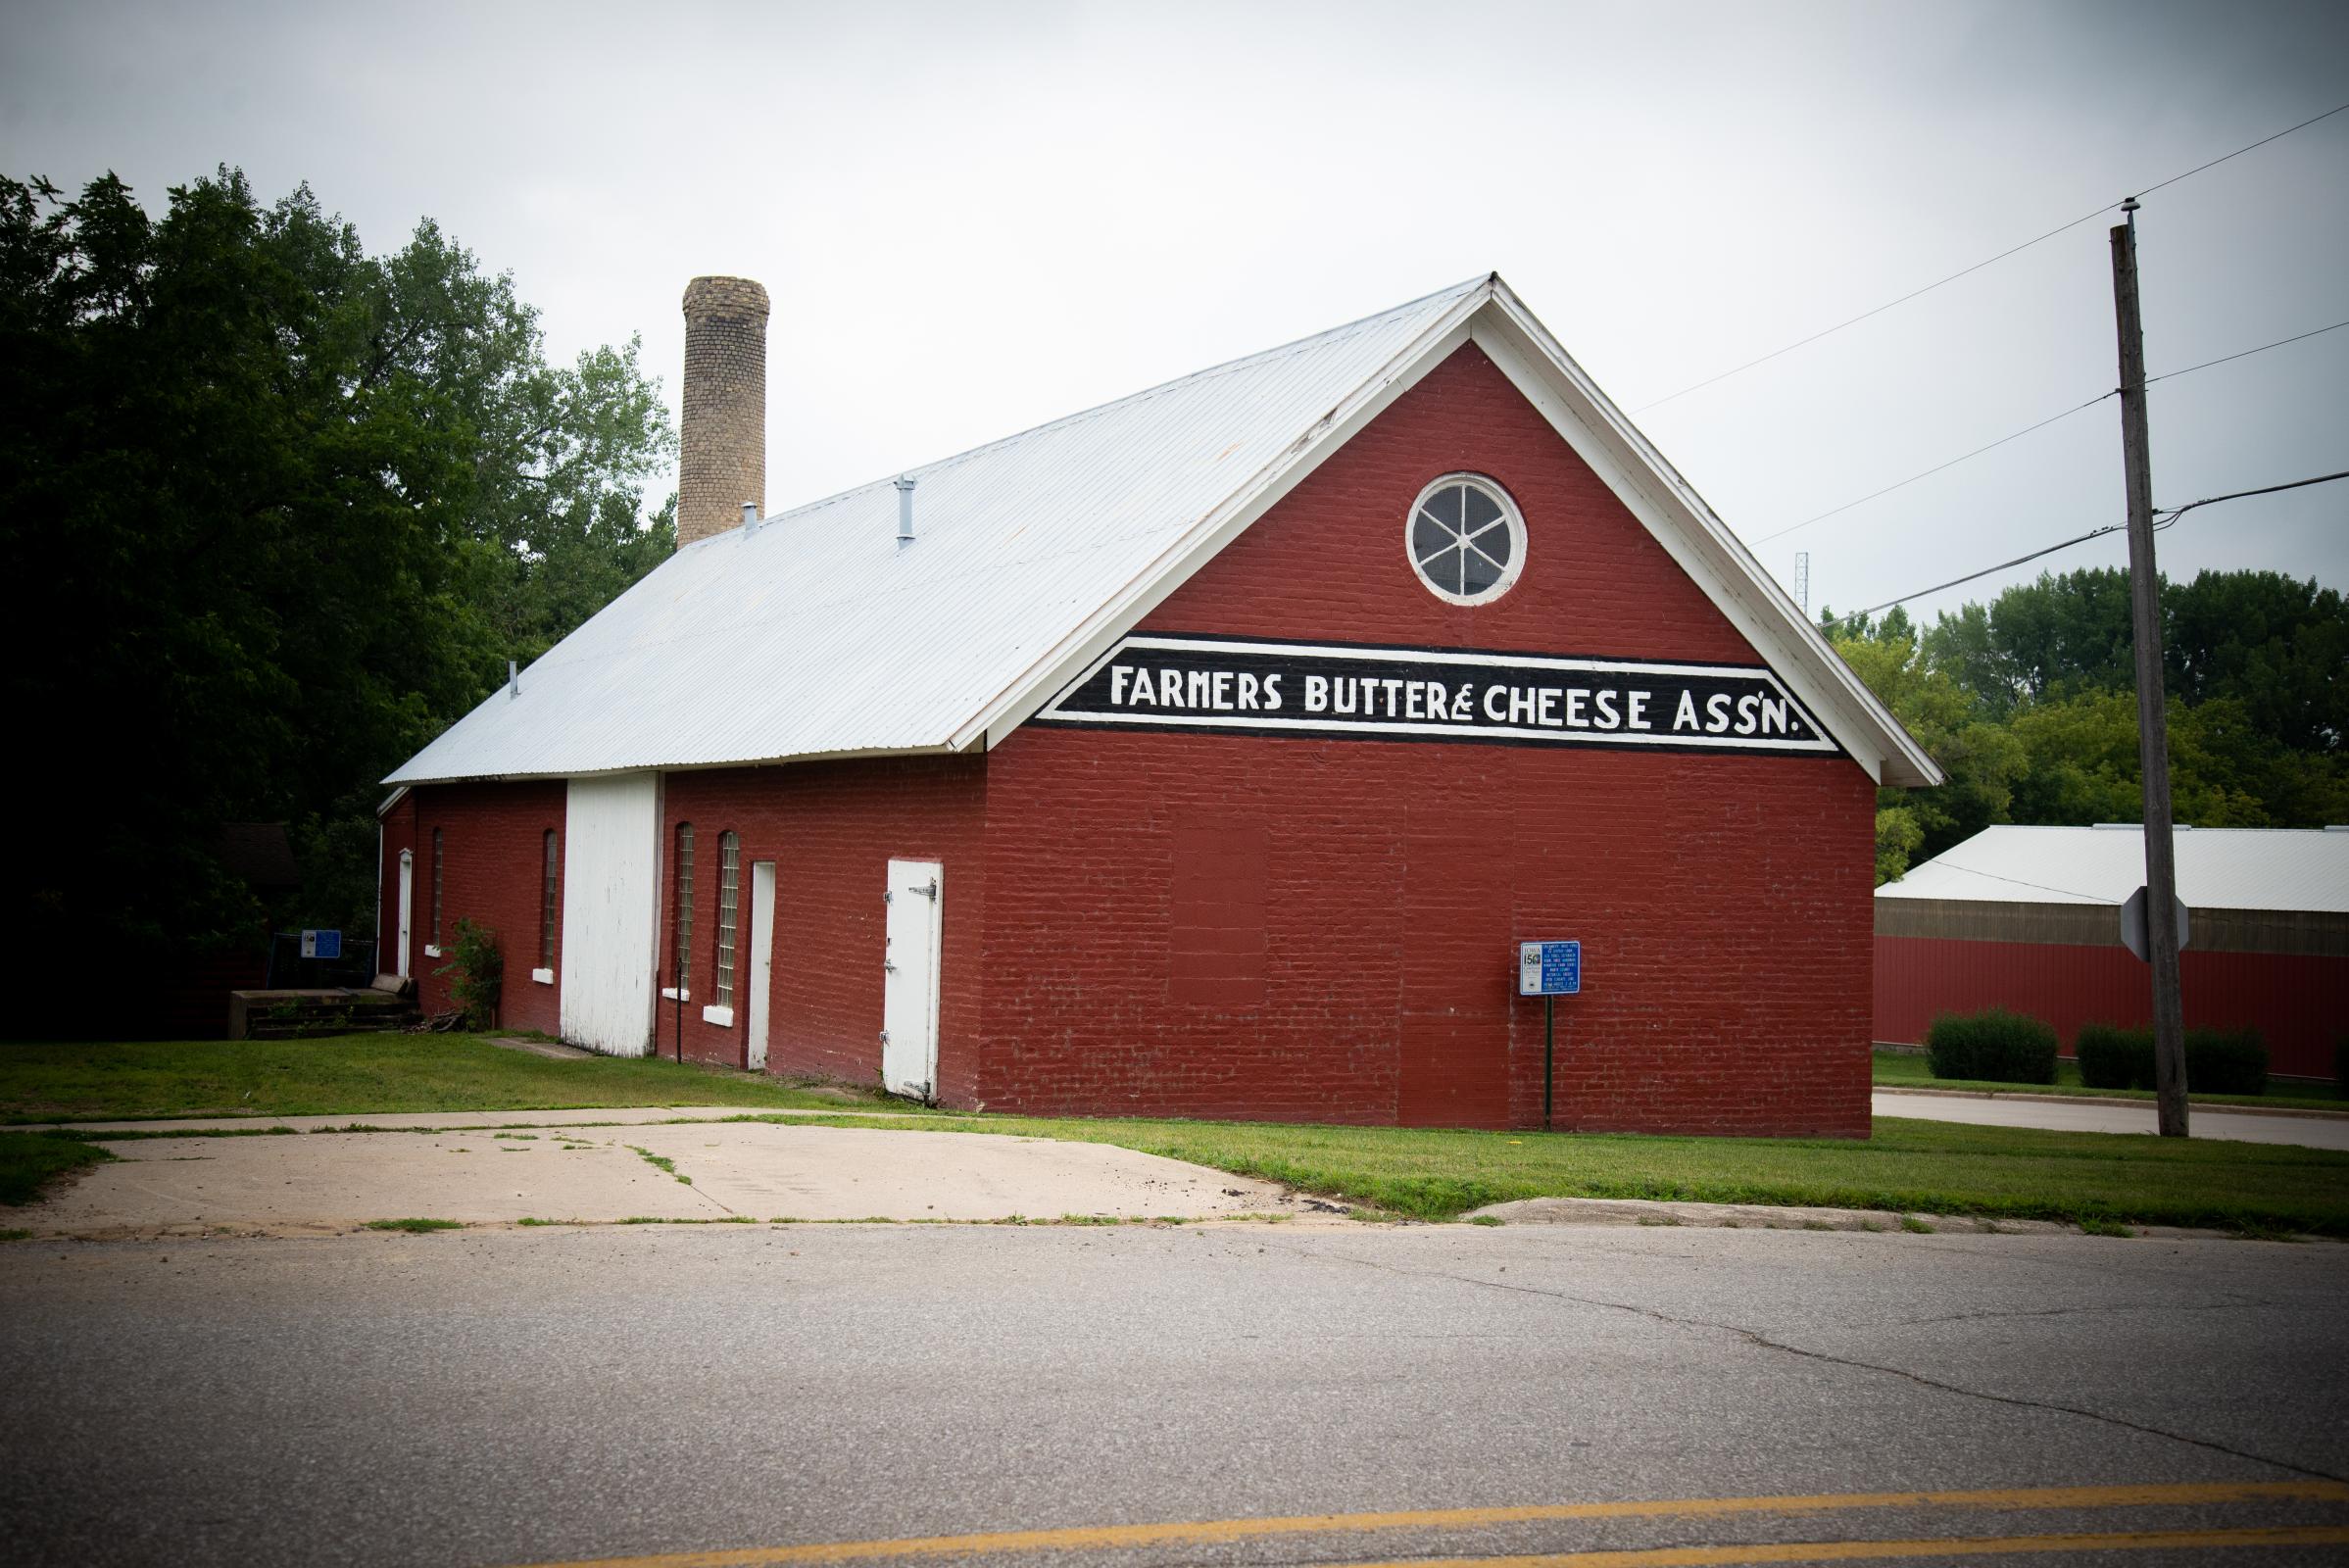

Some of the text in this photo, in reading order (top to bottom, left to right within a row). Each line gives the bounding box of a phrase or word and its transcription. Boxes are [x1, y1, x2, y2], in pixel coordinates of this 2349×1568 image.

[1111, 665, 1799, 735] FARMERS BUTTER & CHEESE ASS'N.
